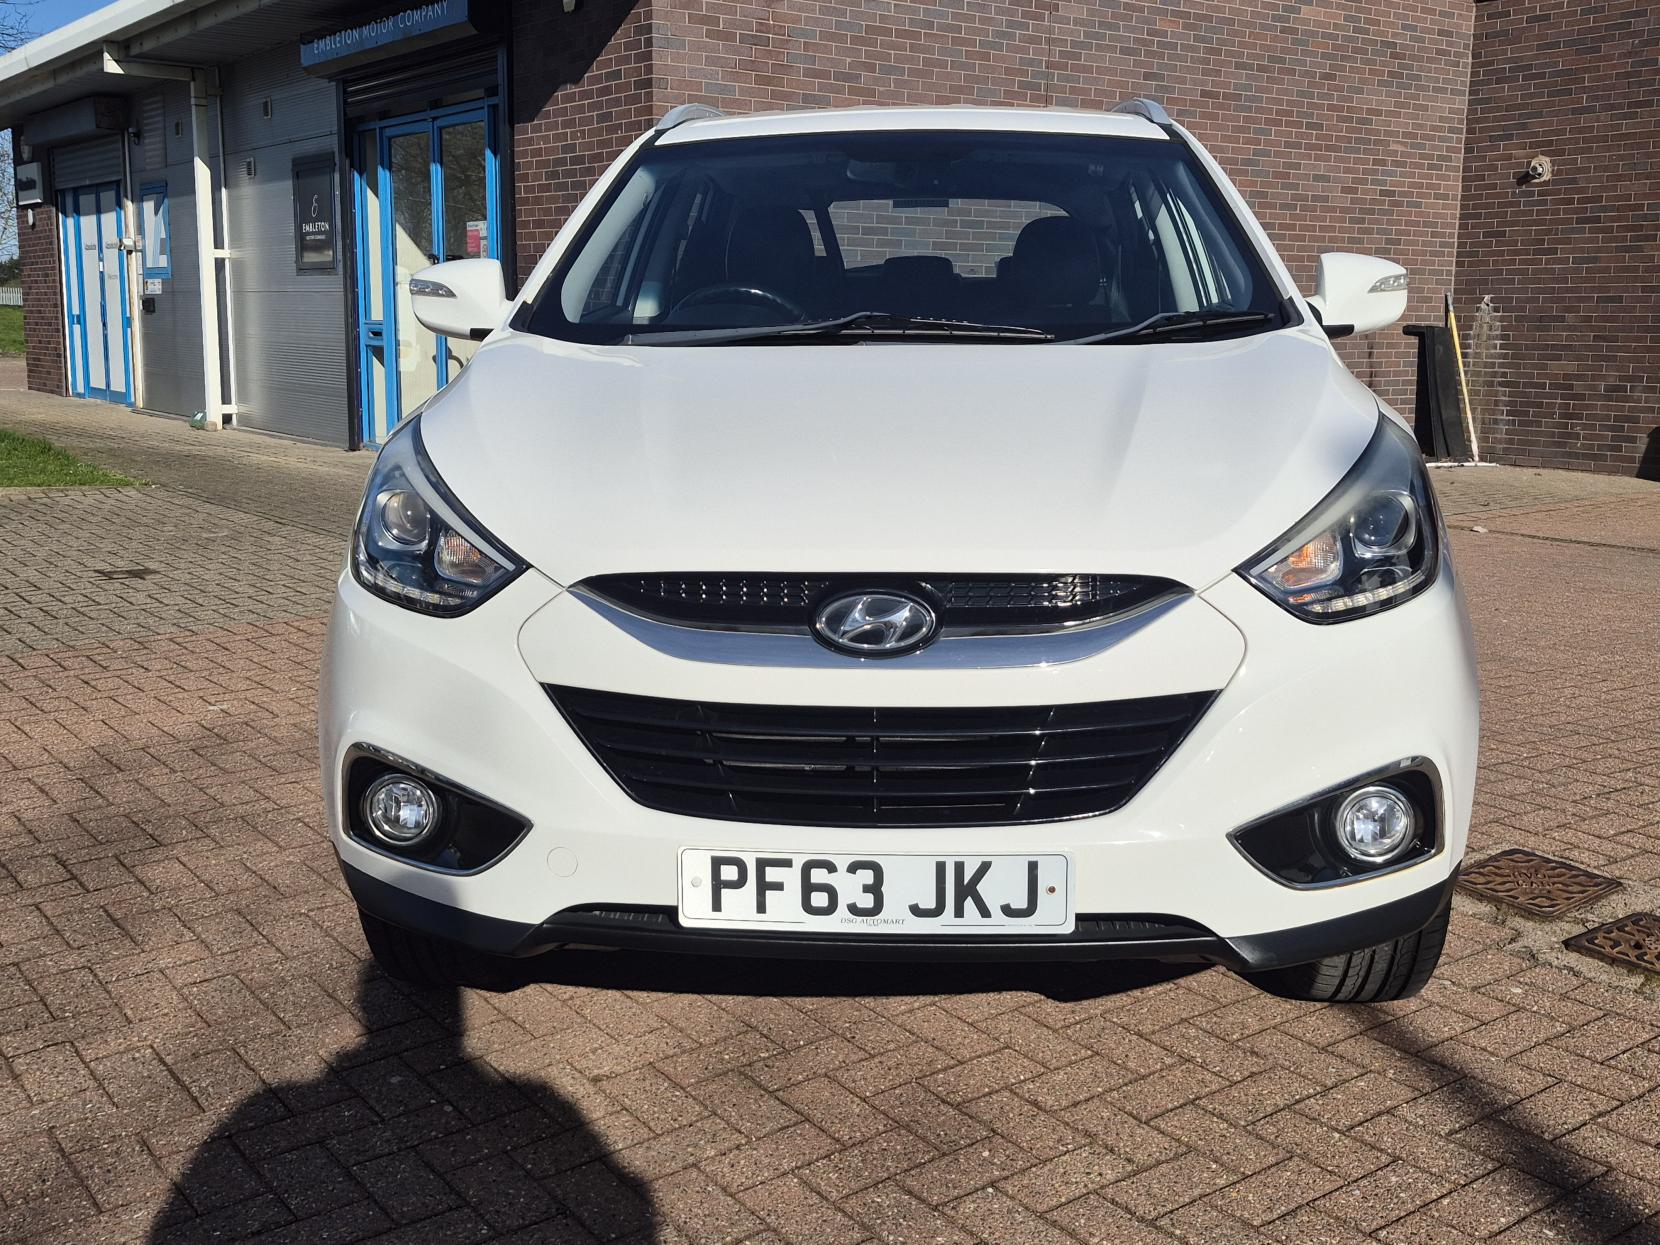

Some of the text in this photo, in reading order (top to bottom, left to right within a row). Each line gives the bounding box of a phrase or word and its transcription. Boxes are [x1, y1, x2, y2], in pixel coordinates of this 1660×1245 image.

[313, 0, 449, 54] EMBLETON MOTOR COMPANY
[302, 221, 330, 233] EMBLETON
[710, 855, 1039, 920] PF63 JKJ
[859, 918, 907, 926] AUTOMART
